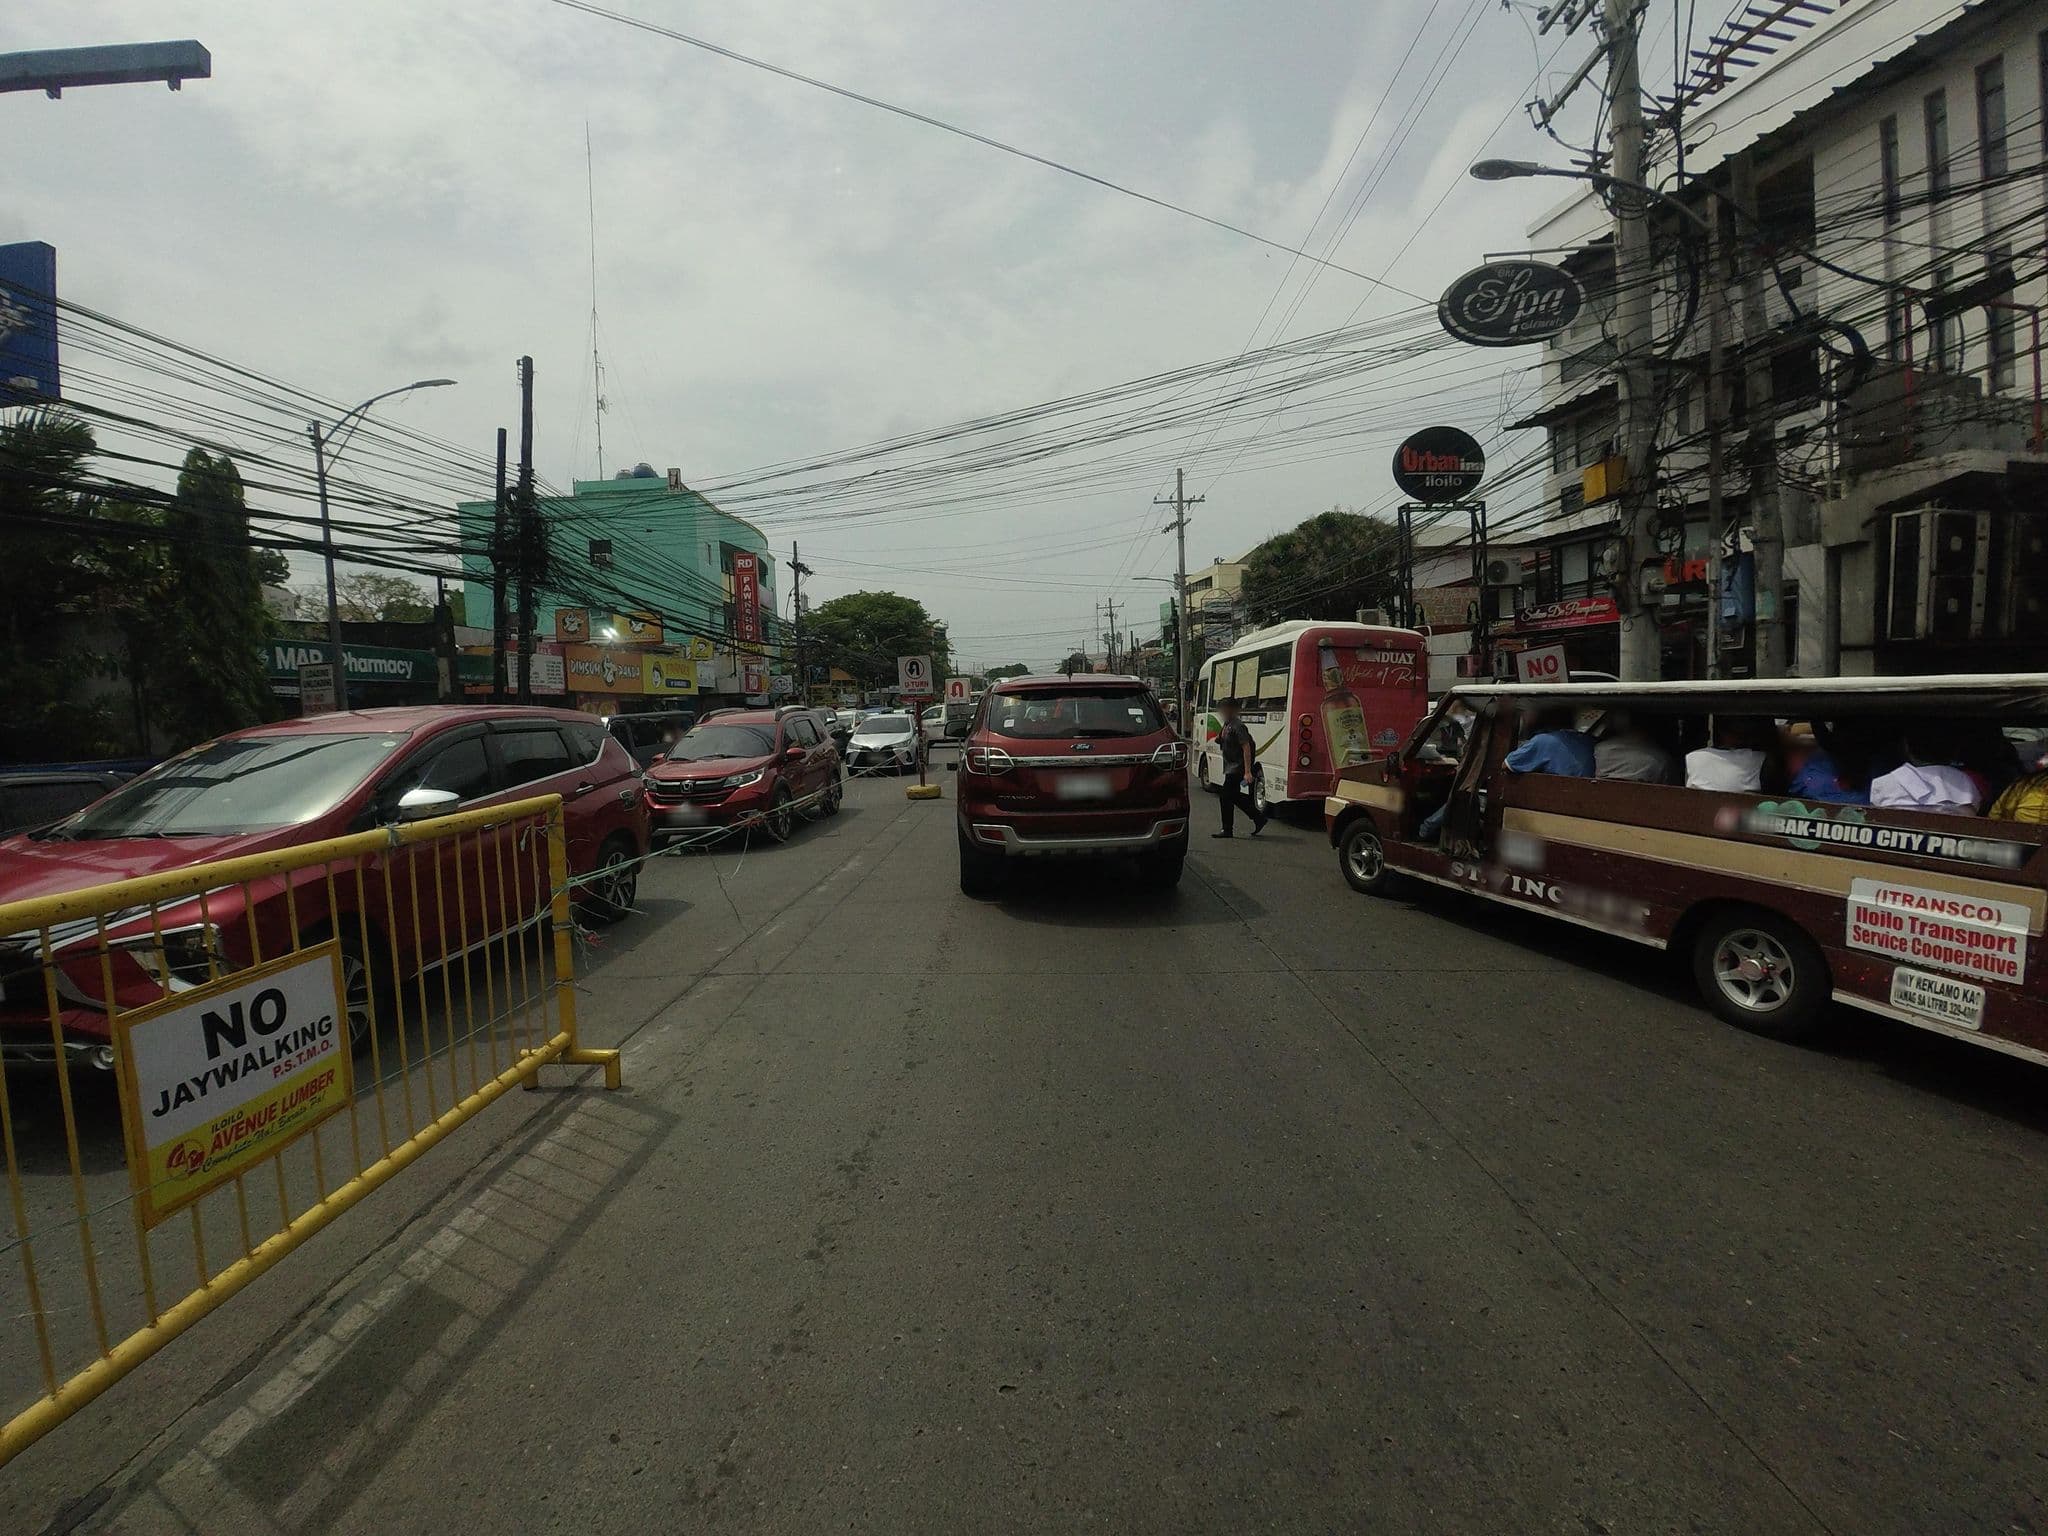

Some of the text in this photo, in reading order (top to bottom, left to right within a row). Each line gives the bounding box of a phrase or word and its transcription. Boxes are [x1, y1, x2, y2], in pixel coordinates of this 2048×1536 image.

[1463, 268, 1566, 335] Spa
[1401, 444, 1460, 472] Urban
[1425, 475, 1463, 487] Iloilo
[737, 558, 753, 569] RD
[569, 659, 601, 676] DIMSUM
[617, 663, 640, 680] PANDA
[1527, 655, 1559, 678] NO
[904, 680, 929, 689] U-TURN
[1876, 827, 1926, 852] CITY
[1451, 861, 1488, 885] ST.
[1875, 888, 2002, 926] (ITRANSCO)
[1855, 906, 2018, 955] Iloilo Transport
[1852, 925, 1908, 952] Service
[1911, 937, 2018, 978] Cooperative
[1916, 978, 1961, 1000] REKLAMO
[1917, 993, 1926, 1008] SA
[201, 987, 288, 1062] NO
[151, 1014, 333, 1118] JAYWALKING
[273, 1038, 334, 1080] P.S.T.M.O.
[210, 1068, 336, 1155] AVENUE LUMBER
[211, 1110, 244, 1133] ILOILO
